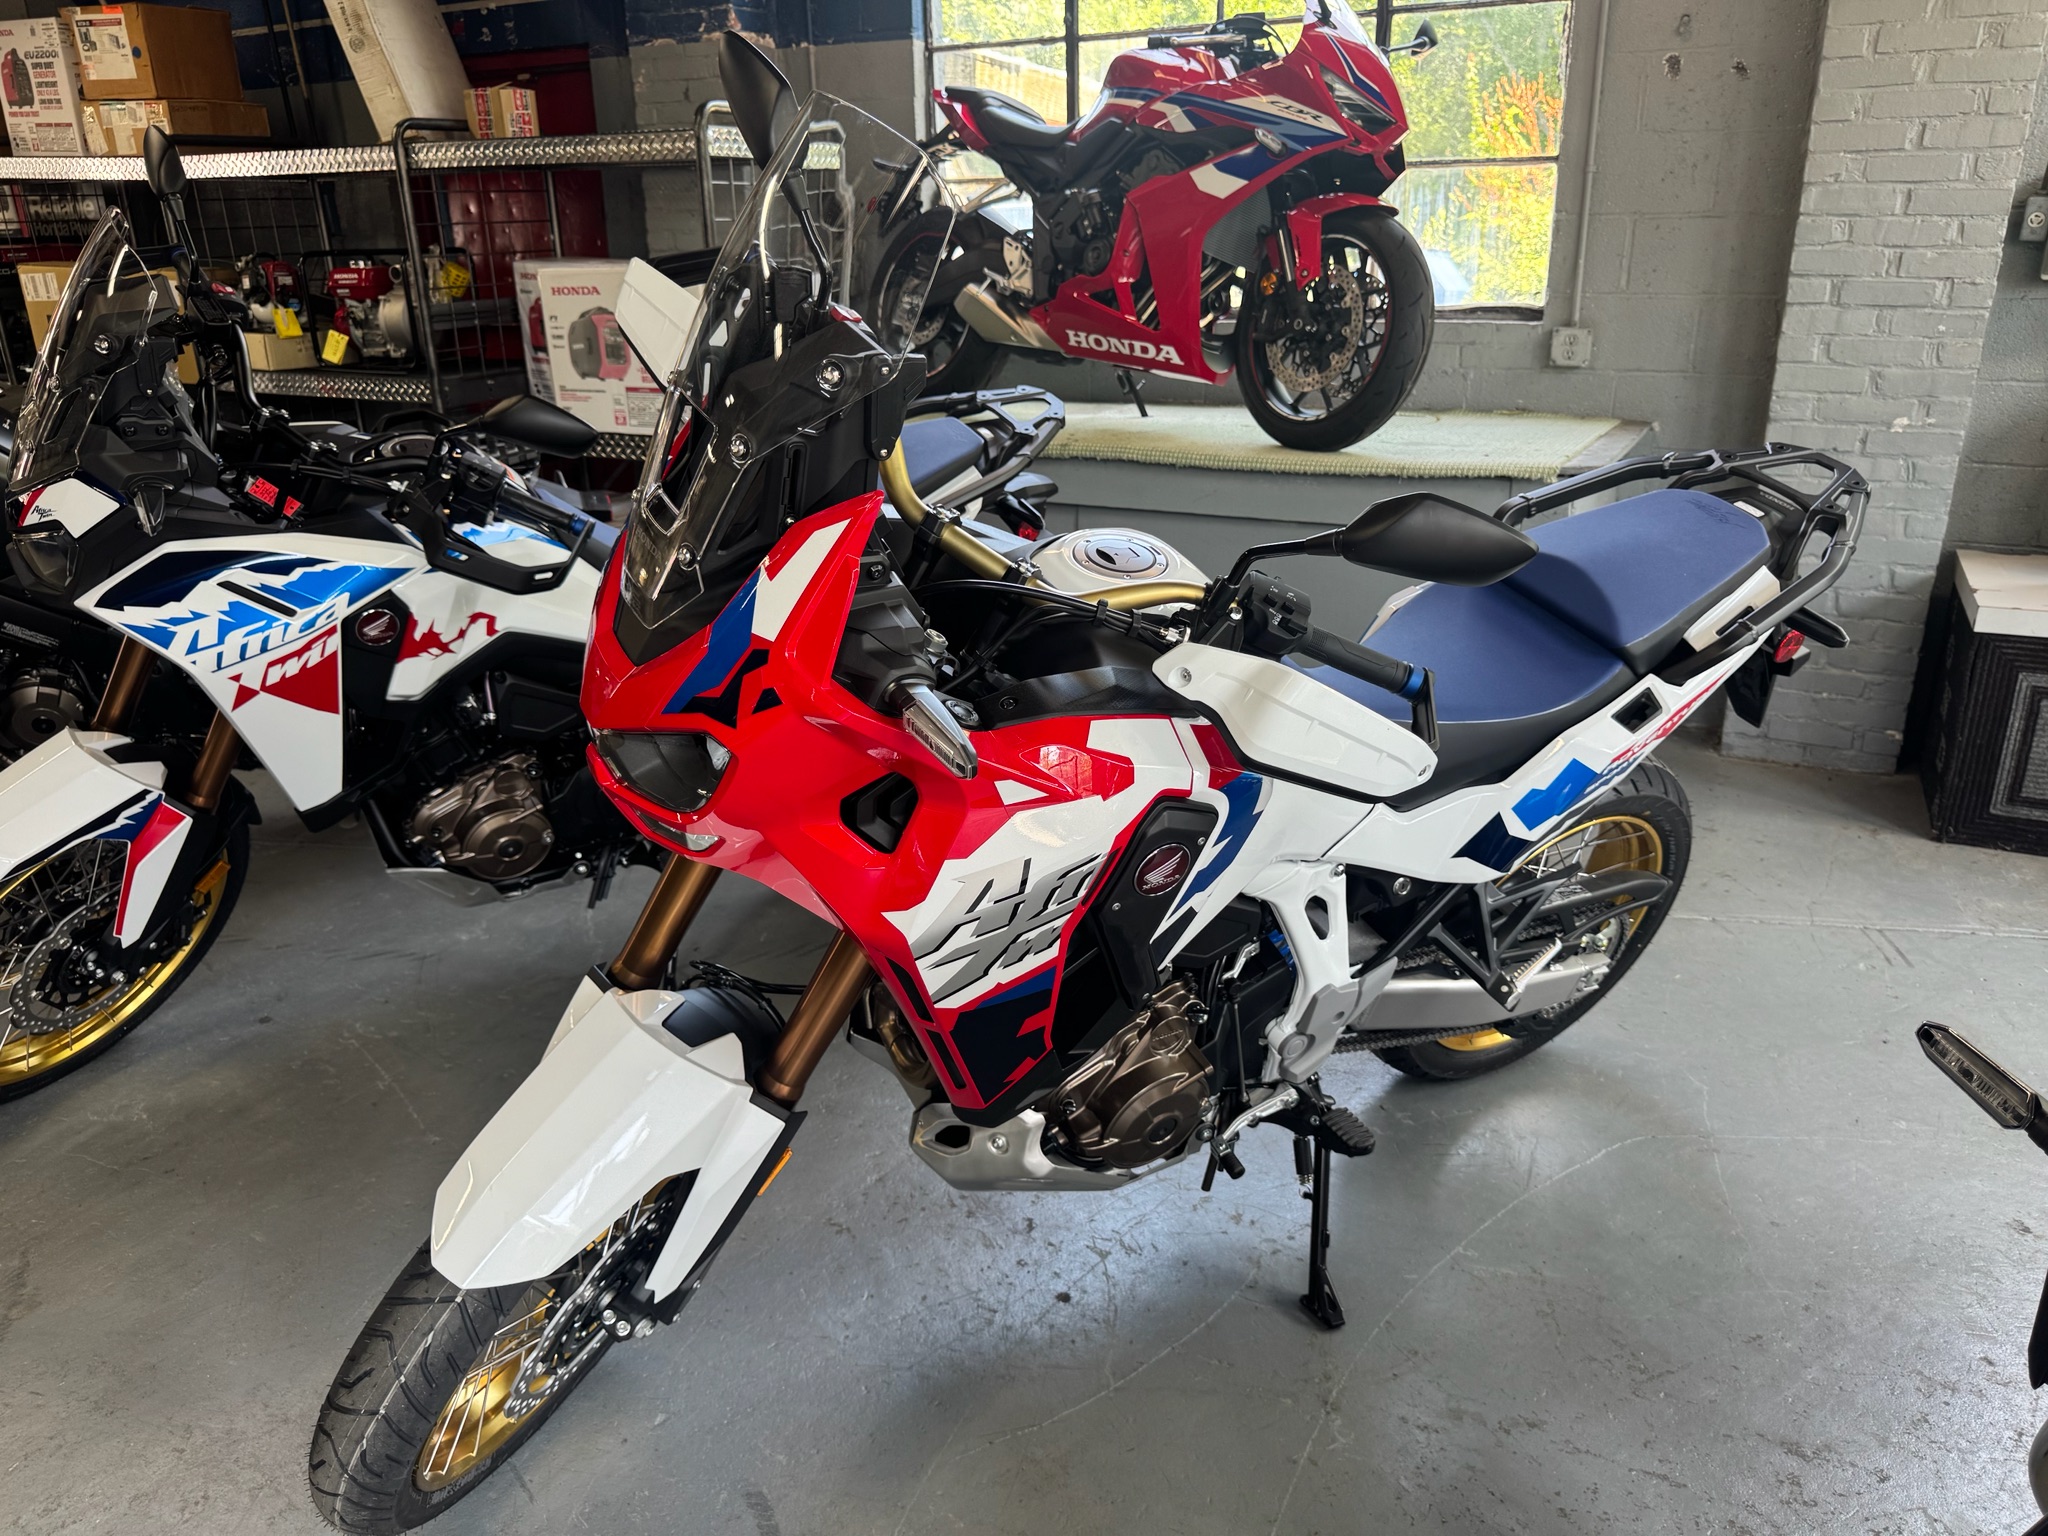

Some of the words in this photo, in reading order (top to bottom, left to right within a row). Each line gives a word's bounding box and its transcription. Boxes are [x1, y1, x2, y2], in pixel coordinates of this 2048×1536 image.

[33, 71, 57, 79] GENERATOR
[1271, 101, 1324, 123] CBR
[34, 222, 68, 236] Honda
[551, 286, 601, 296] HONDA
[1066, 329, 1184, 365] HONDA
[1759, 491, 1795, 510] HONDA
[31, 505, 56, 515] Africa
[167, 592, 350, 672] Africa
[1142, 874, 1181, 891] HONDA
